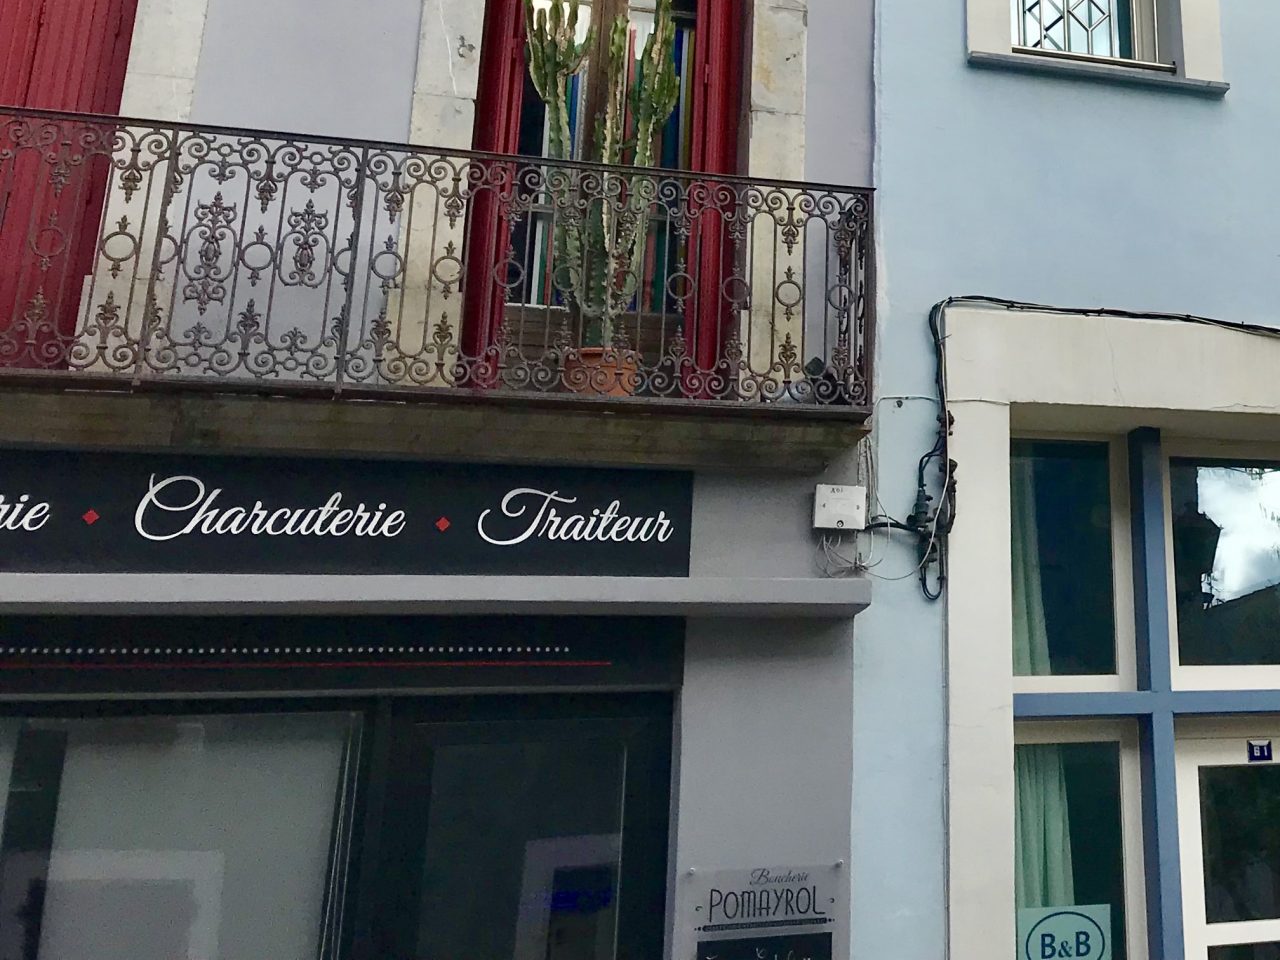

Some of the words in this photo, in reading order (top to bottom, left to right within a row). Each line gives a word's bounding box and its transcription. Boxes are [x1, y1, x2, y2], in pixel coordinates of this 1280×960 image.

[134, 473, 406, 541] Charcuterie
[477, 487, 674, 546] Traiteur
[709, 885, 826, 923] POMAYROL
[1040, 930, 1091, 959] B&B
